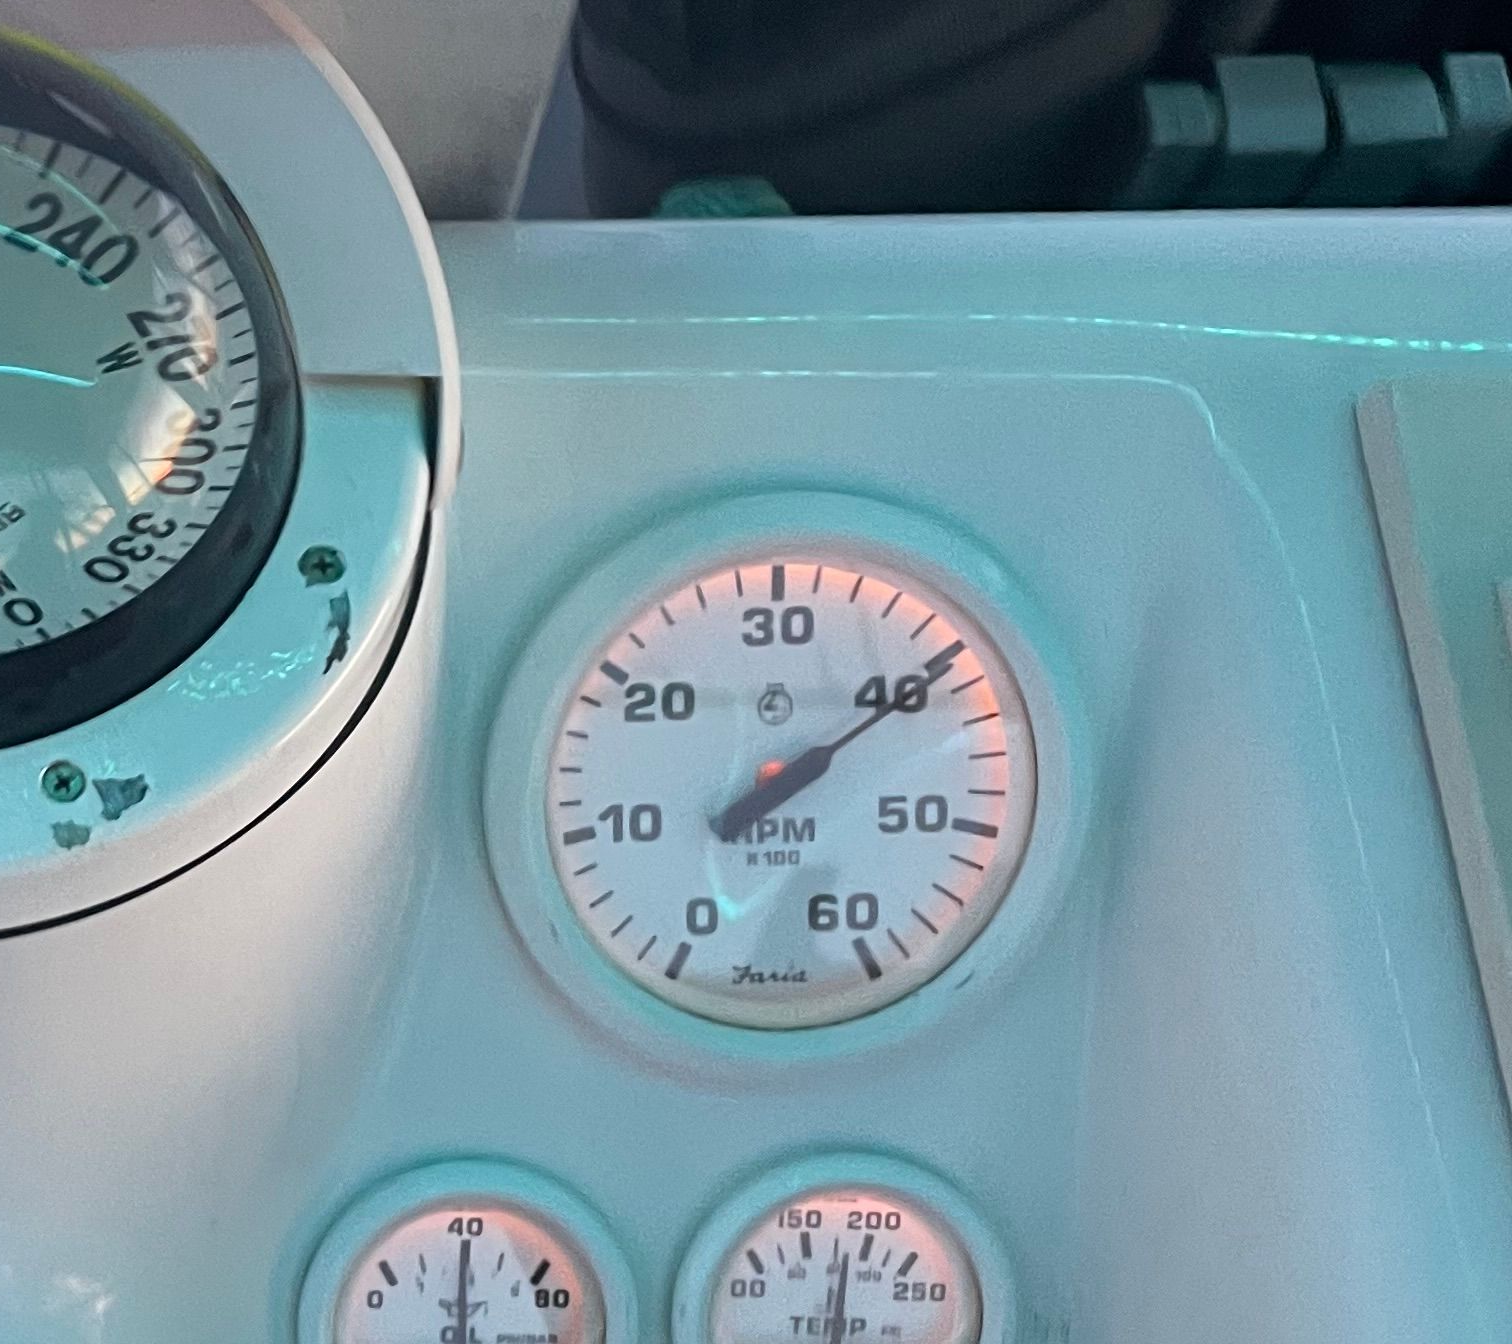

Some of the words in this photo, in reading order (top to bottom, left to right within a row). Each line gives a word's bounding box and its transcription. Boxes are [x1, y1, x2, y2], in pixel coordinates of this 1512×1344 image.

[2, 191, 140, 288] 240
[95, 341, 144, 376] W
[83, 510, 177, 584] 330
[3, 596, 45, 628] 0
[741, 605, 815, 647] 30
[623, 681, 696, 723] 20
[854, 673, 929, 714] 40
[597, 803, 663, 843] 10
[877, 794, 949, 834] 50
[686, 896, 719, 936] 0
[807, 892, 880, 933] 60
[447, 1216, 484, 1237] 40
[778, 1209, 822, 1229] 150
[847, 1211, 901, 1231] 200
[366, 1289, 384, 1309] 0
[730, 1279, 766, 1298] 00
[892, 1282, 947, 1302] 250
